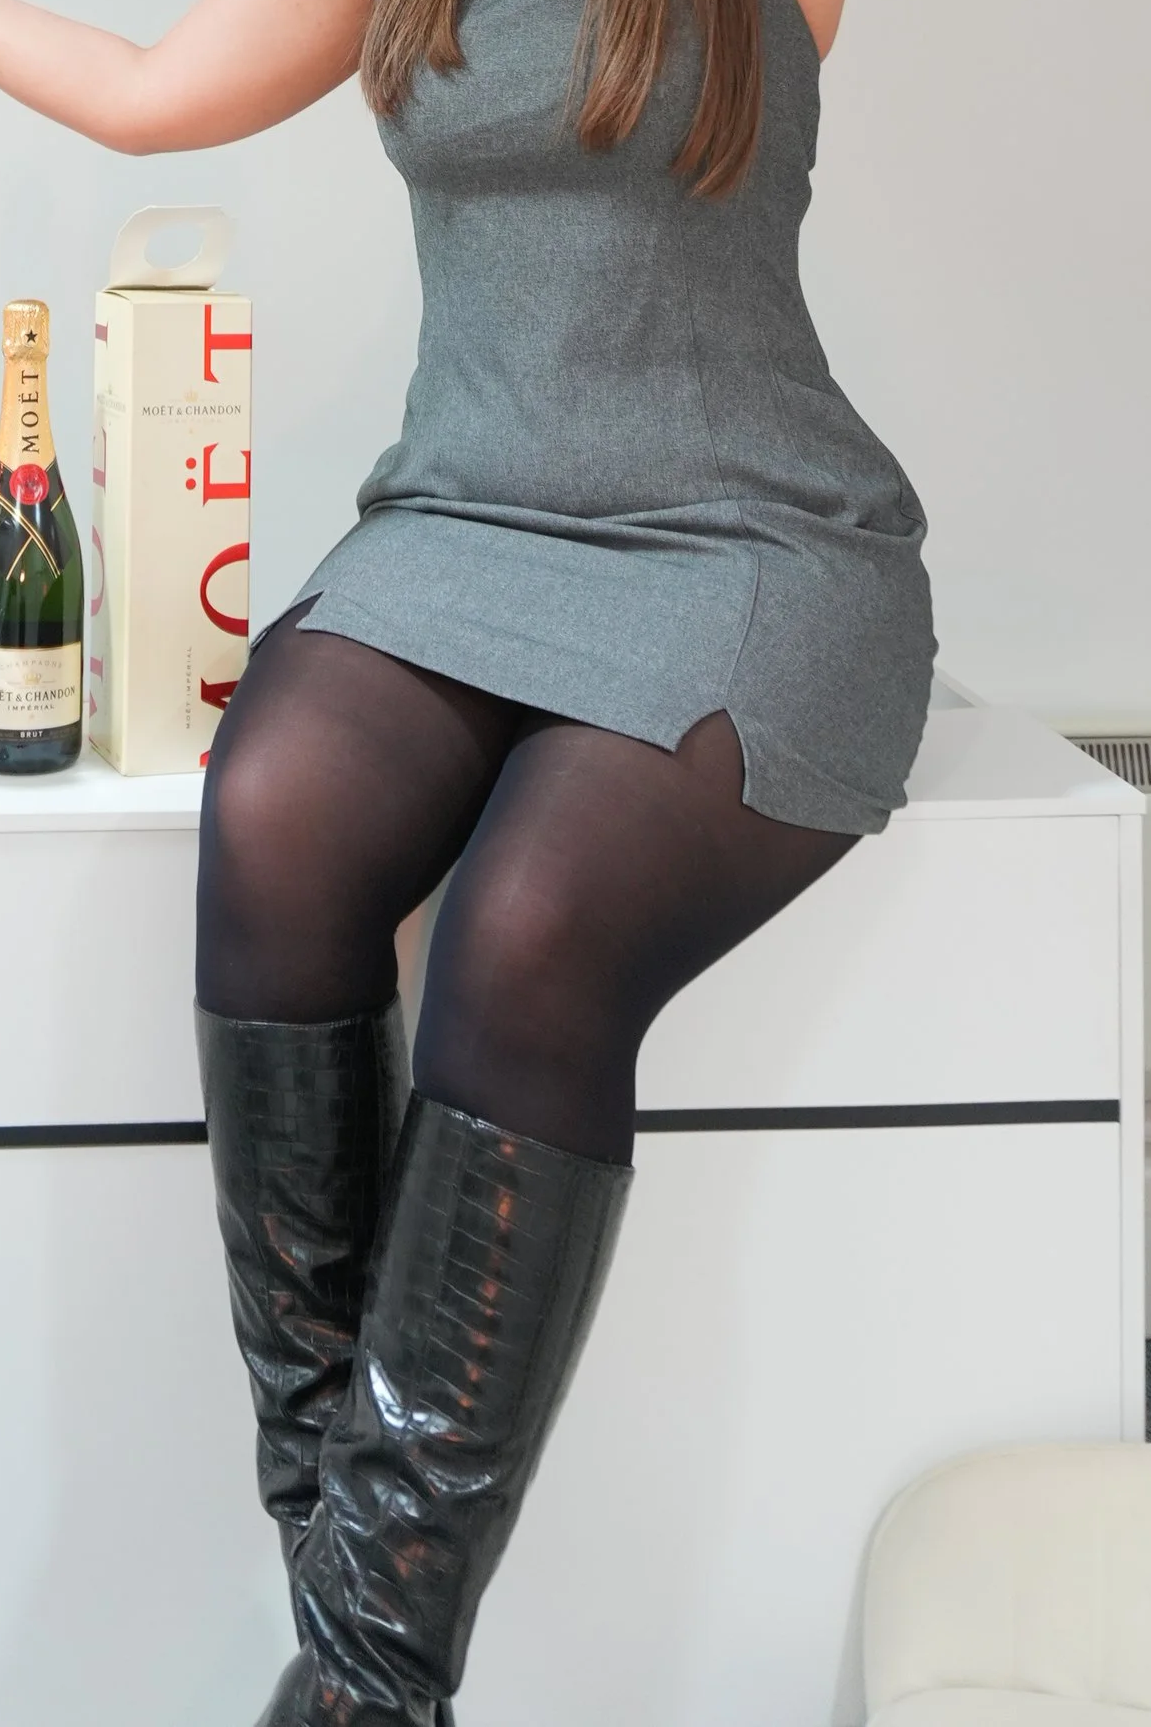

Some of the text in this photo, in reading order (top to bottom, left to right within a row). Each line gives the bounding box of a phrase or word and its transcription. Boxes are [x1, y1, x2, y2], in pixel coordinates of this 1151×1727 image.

[18, 370, 39, 454] MOËT
[142, 404, 241, 416] MOËT & CHANDON
[15, 693, 23, 703] &
[25, 685, 76, 702] CHANDON
[19, 731, 43, 739] BRUT
